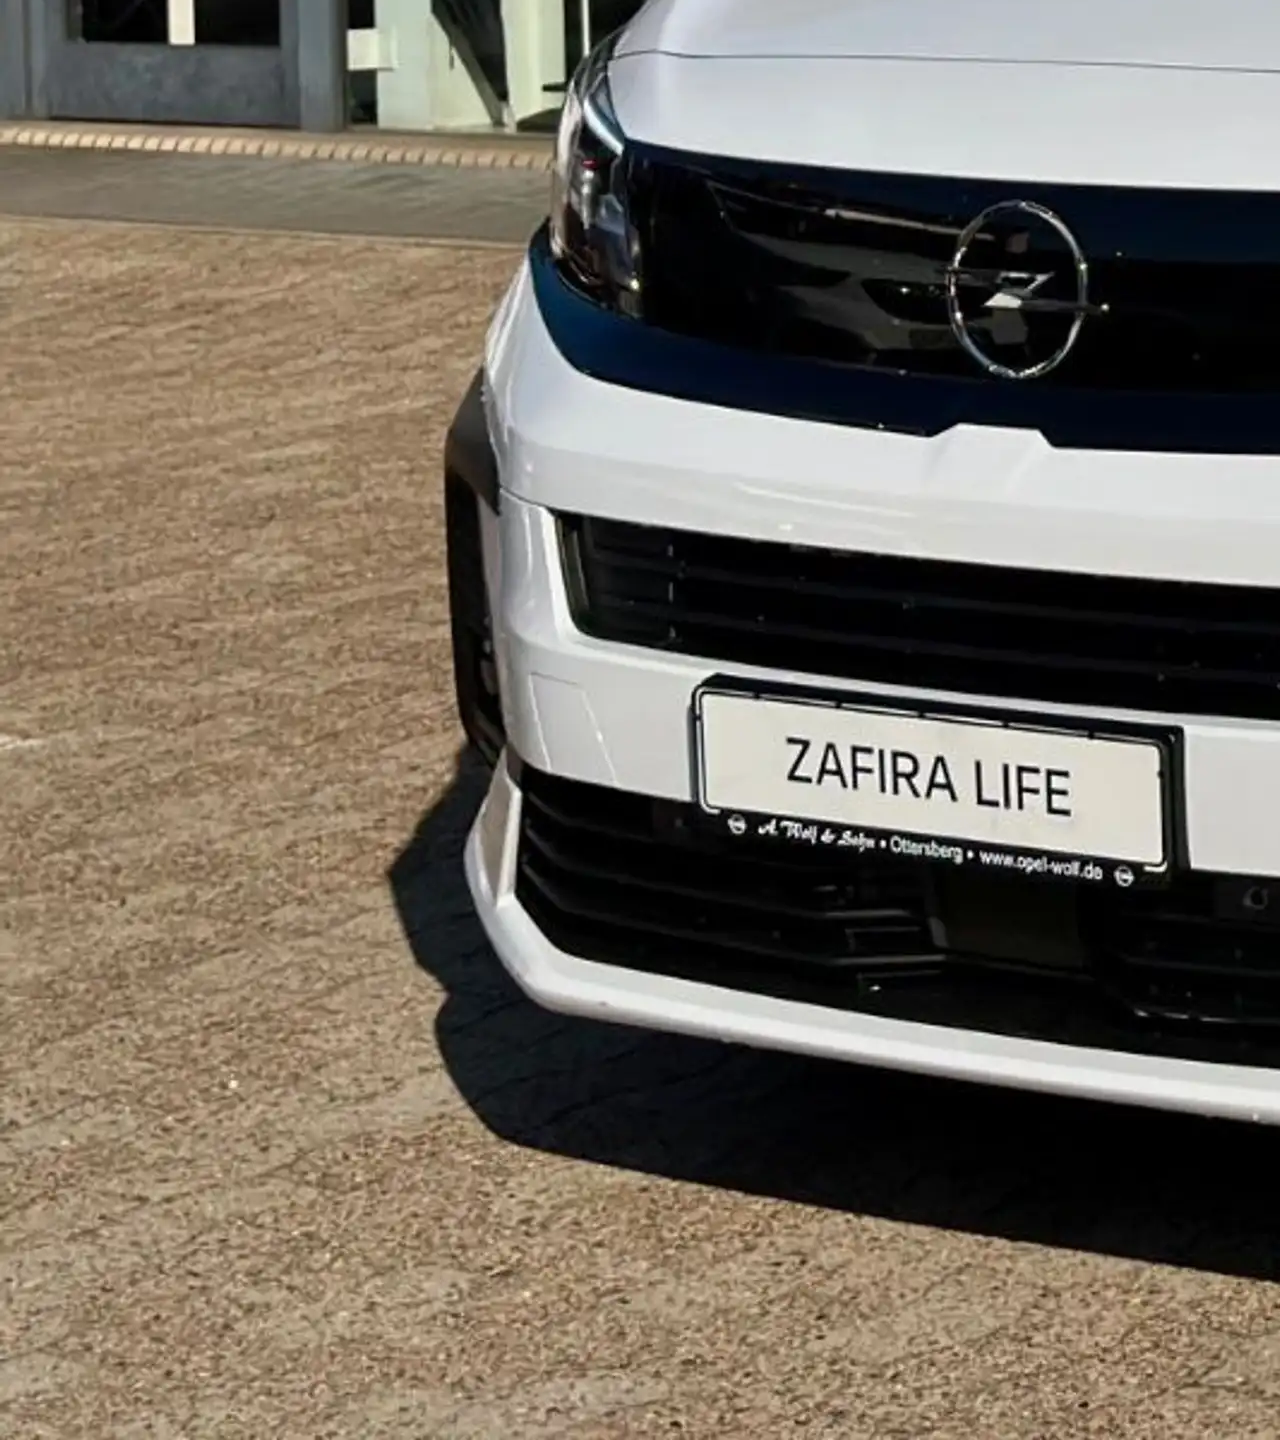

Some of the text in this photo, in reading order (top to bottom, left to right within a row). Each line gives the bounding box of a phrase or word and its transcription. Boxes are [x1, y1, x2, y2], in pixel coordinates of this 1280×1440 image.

[785, 736, 1073, 818] ZAFIRA LIFE
[889, 833, 965, 865] Ottersberg
[978, 847, 1105, 882] www.opel-wolf.de
